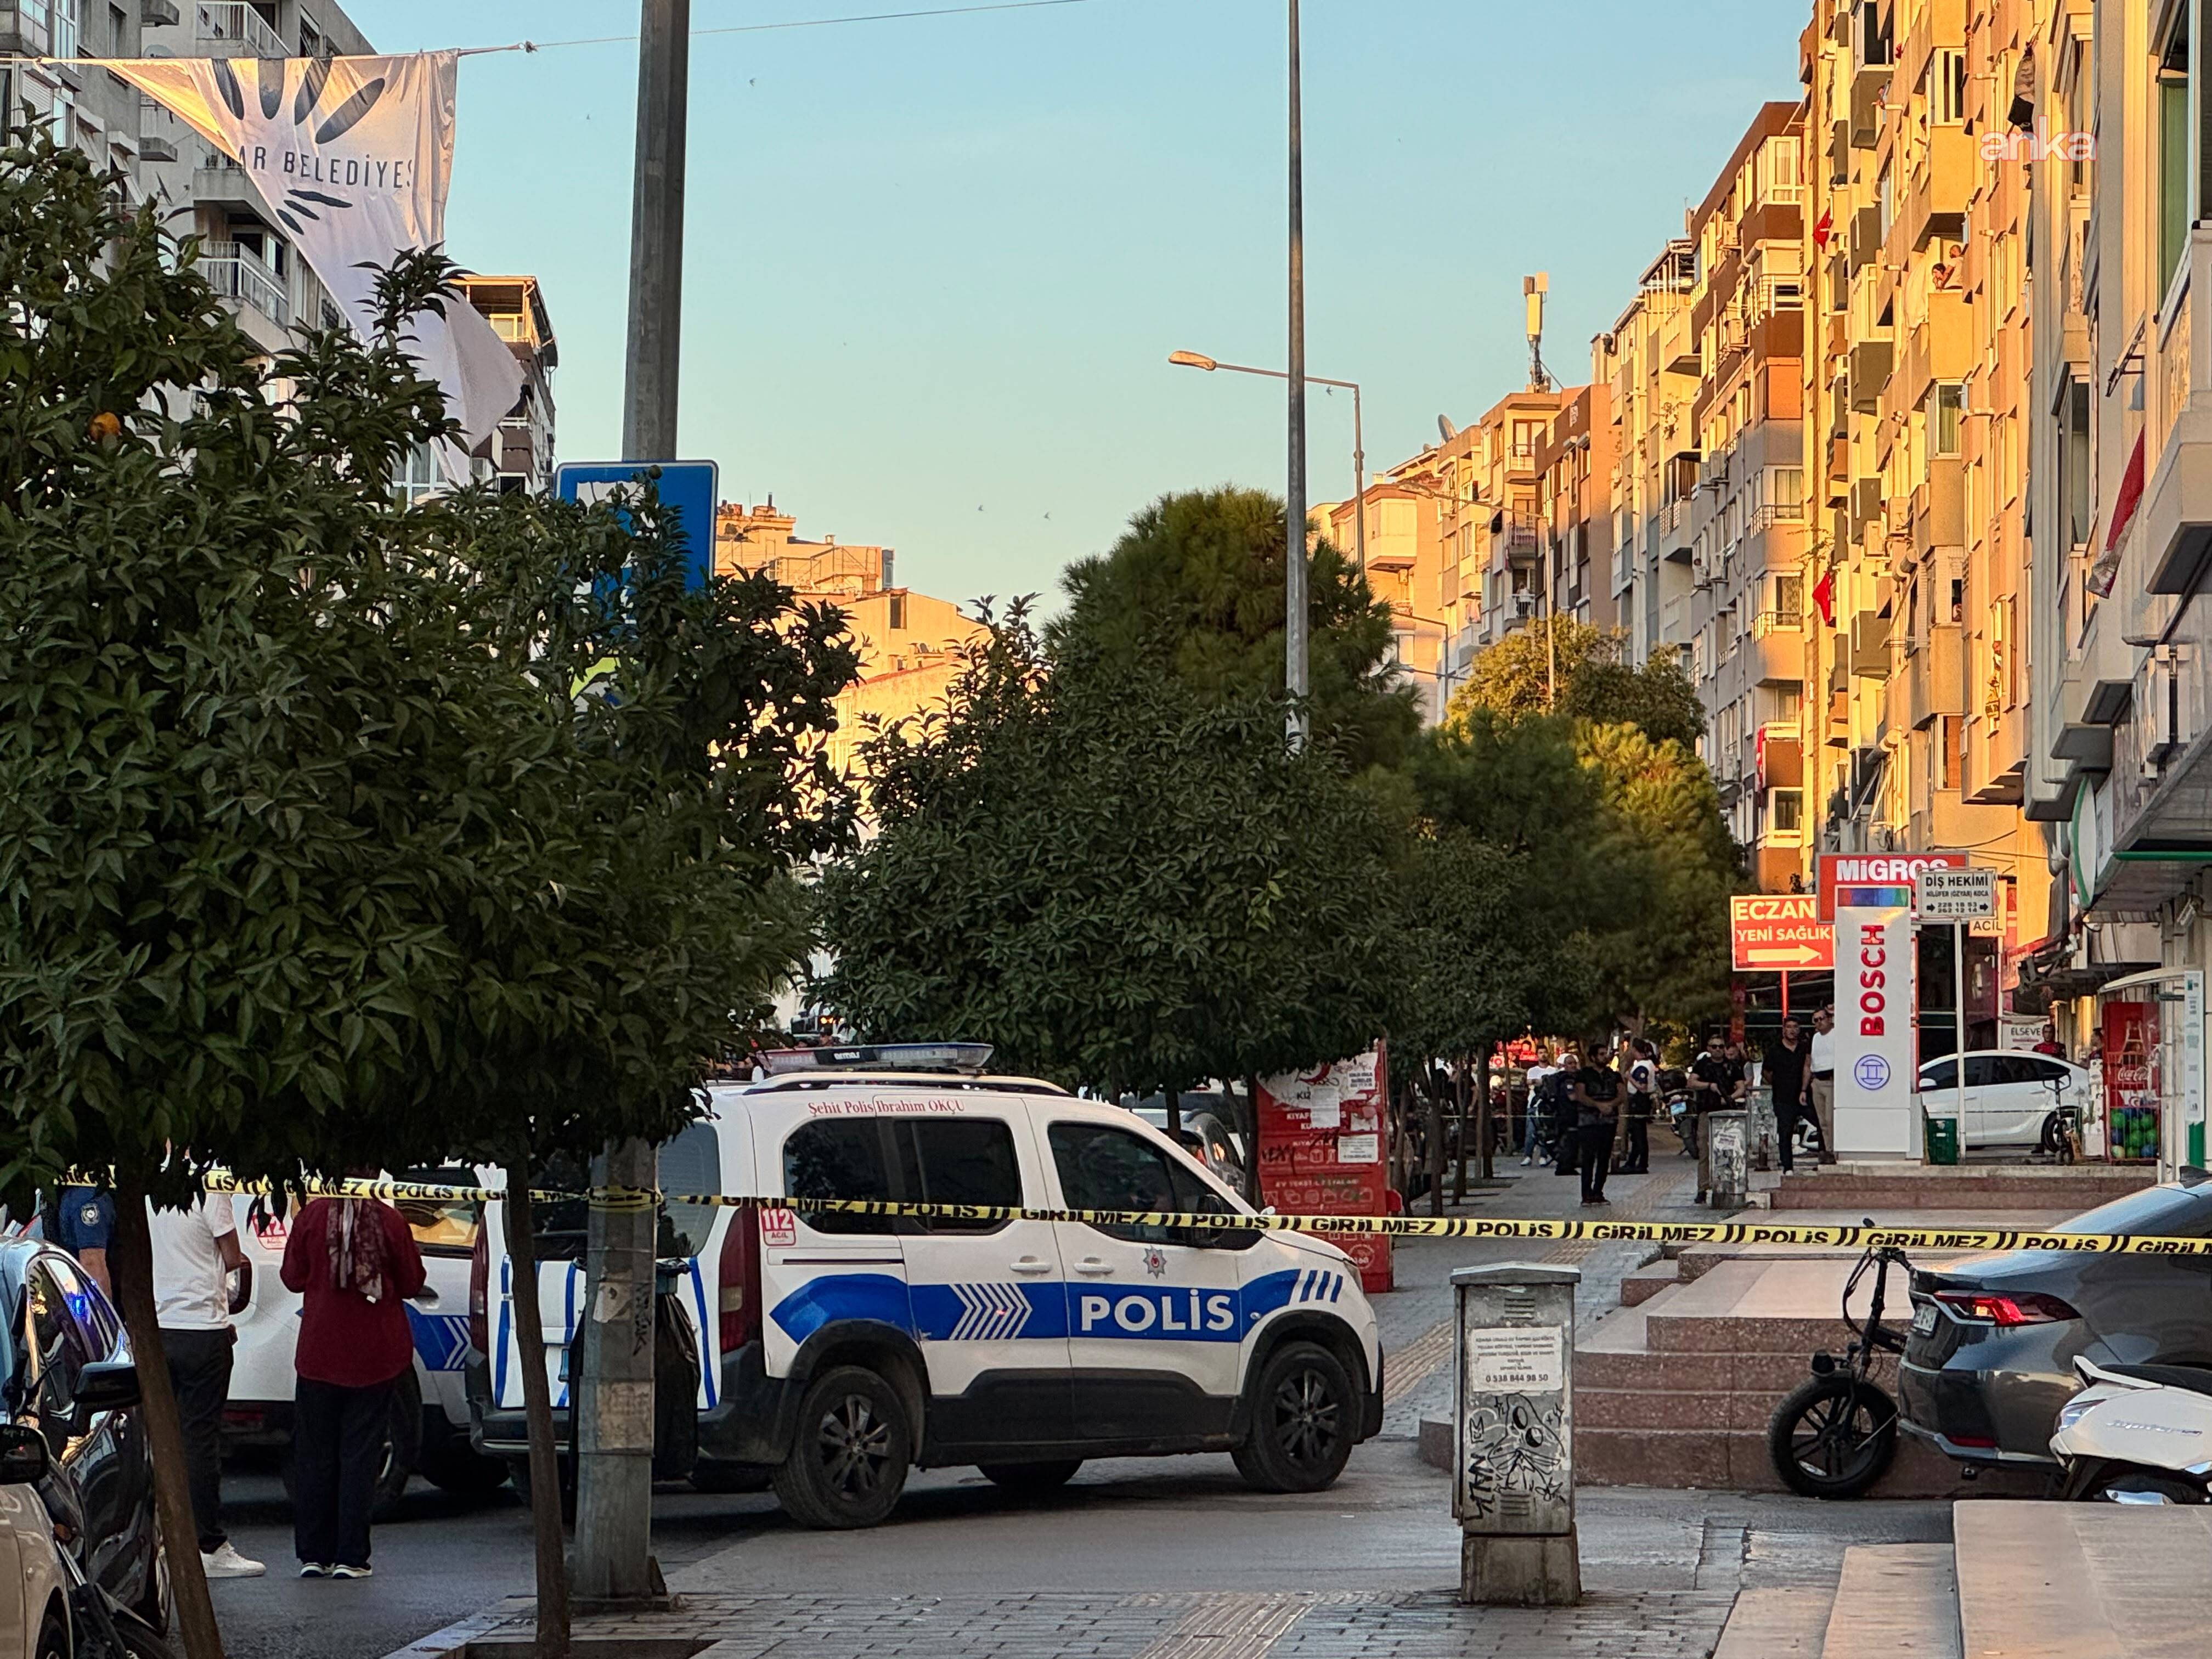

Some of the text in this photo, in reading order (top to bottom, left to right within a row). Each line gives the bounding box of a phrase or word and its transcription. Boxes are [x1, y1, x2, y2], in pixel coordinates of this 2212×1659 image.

[239, 145, 266, 170] AR
[1926, 873, 1988, 889] DİŞ HEKİMİ
[1735, 900, 1816, 921] ECZAN
[1736, 924, 1831, 942] YENİ SAĞLIK
[1860, 925, 1886, 1036] BOSCH
[808, 1102, 842, 1118] Şehit
[844, 1101, 873, 1113] Polis
[928, 1098, 965, 1115] OKÇU
[1286, 1112, 1311, 1120] KIYAF
[763, 1209, 793, 1229] 112
